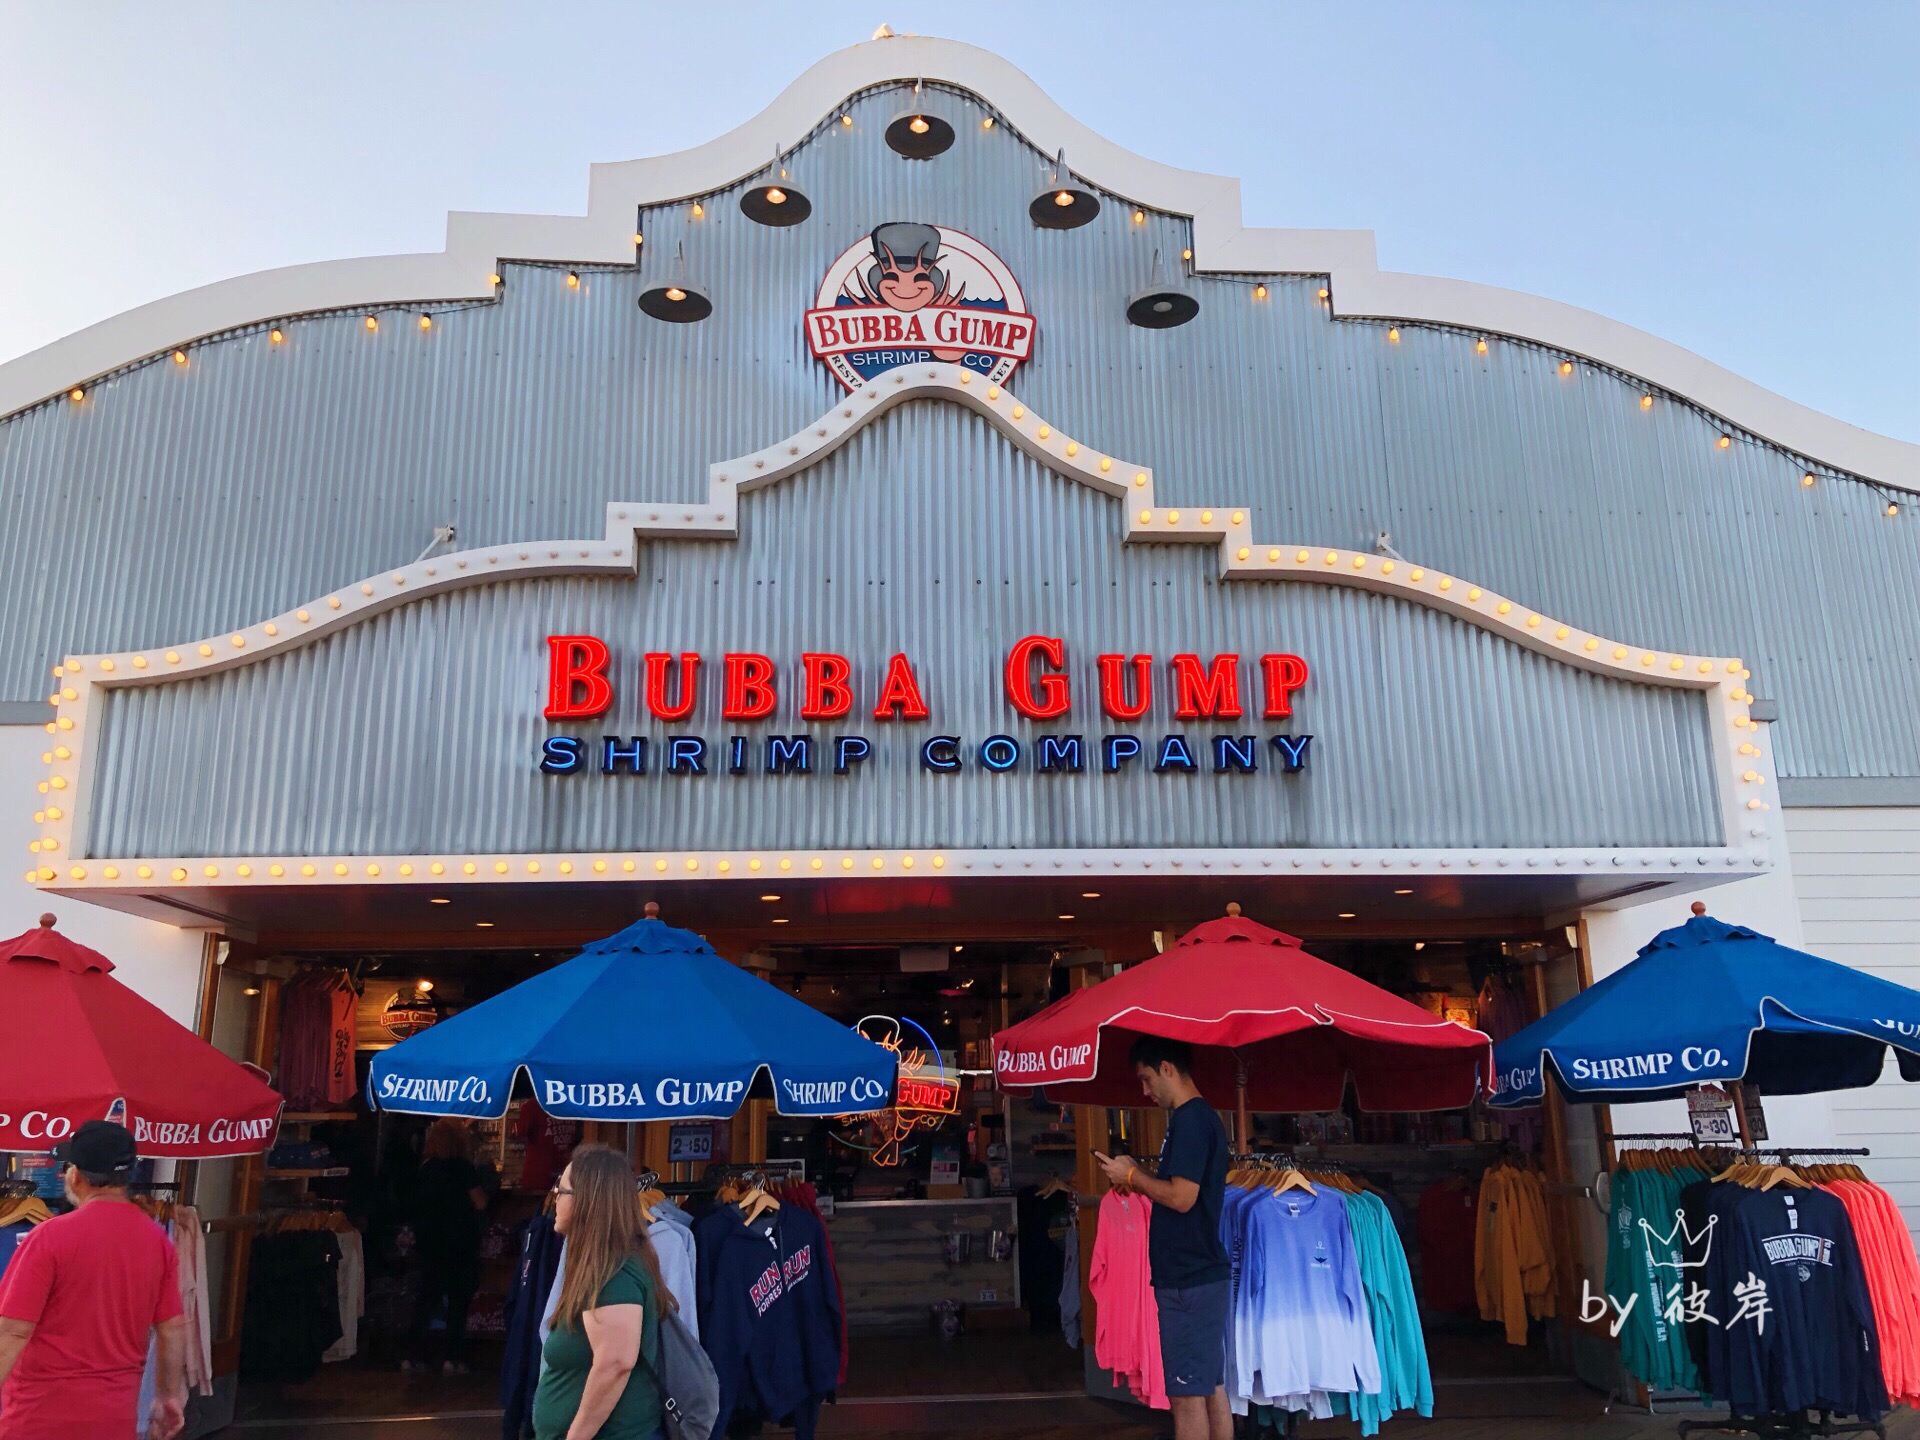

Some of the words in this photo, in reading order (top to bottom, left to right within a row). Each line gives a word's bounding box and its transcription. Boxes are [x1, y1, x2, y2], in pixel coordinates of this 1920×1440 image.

[815, 313, 926, 347] BUBBA
[934, 310, 1028, 350] GUMP
[852, 351, 931, 366] SHRIMP
[544, 634, 930, 722] BUBBA
[1006, 634, 1310, 722] GUMP
[540, 735, 874, 775] SHRIMP
[922, 734, 1313, 774] COMPANY
[998, 1049, 1046, 1073] BUBBA
[1050, 1044, 1091, 1071] GUMP
[1572, 1052, 1673, 1080] SHRIMP
[379, 1074, 458, 1102] SHRIMP
[545, 1079, 647, 1107] BUBBA
[656, 1078, 744, 1106] GUMP
[783, 1079, 846, 1104] SHRIMP
[898, 1078, 951, 1108] GUMP
[134, 1116, 200, 1144] BUBBA
[208, 1118, 273, 1143] GUMP
[1695, 1120, 1703, 1134] 2
[1710, 1119, 1728, 1134] $30
[673, 1137, 682, 1154] 2
[750, 1261, 781, 1307] RUN
[783, 1244, 811, 1285] RUN
[758, 1282, 783, 1317] FORREST
